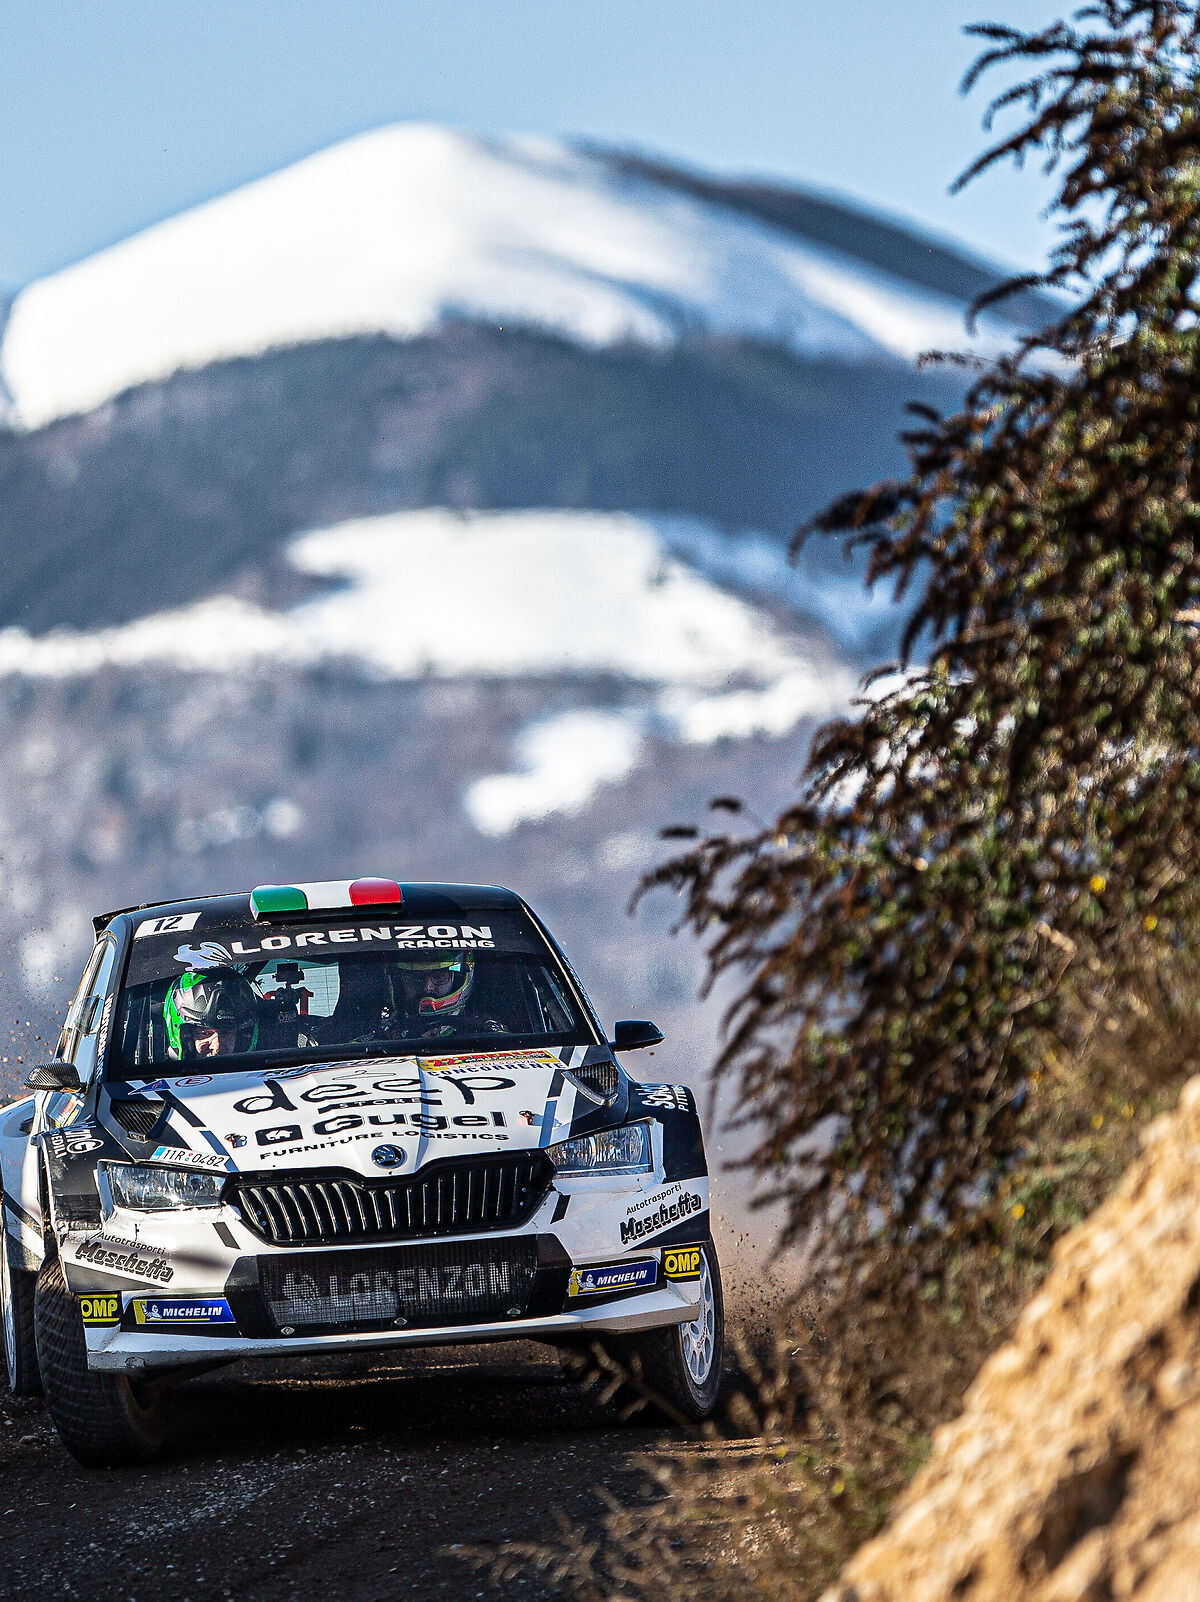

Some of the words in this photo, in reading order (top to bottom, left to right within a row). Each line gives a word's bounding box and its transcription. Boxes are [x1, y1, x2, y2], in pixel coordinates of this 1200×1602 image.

[153, 916, 183, 932] 12
[230, 925, 493, 954] LORENZON
[398, 939, 496, 949] RACING
[427, 1062, 566, 1077] CONCORRENTE
[233, 1076, 517, 1115] deep
[339, 1097, 421, 1109] STORE
[311, 1111, 507, 1135] Gugel
[259, 1130, 384, 1160] FURNITURE
[392, 1130, 510, 1141] LOGISTICS
[625, 1182, 682, 1216] Autotrasporti
[98, 1231, 166, 1255] Autotrasporti
[664, 1252, 700, 1273] OMP
[329, 1261, 510, 1308] LORENZON
[596, 1269, 648, 1287] MICHELIN
[80, 1299, 118, 1318] OMP
[162, 1306, 223, 1317] MICHELIN
